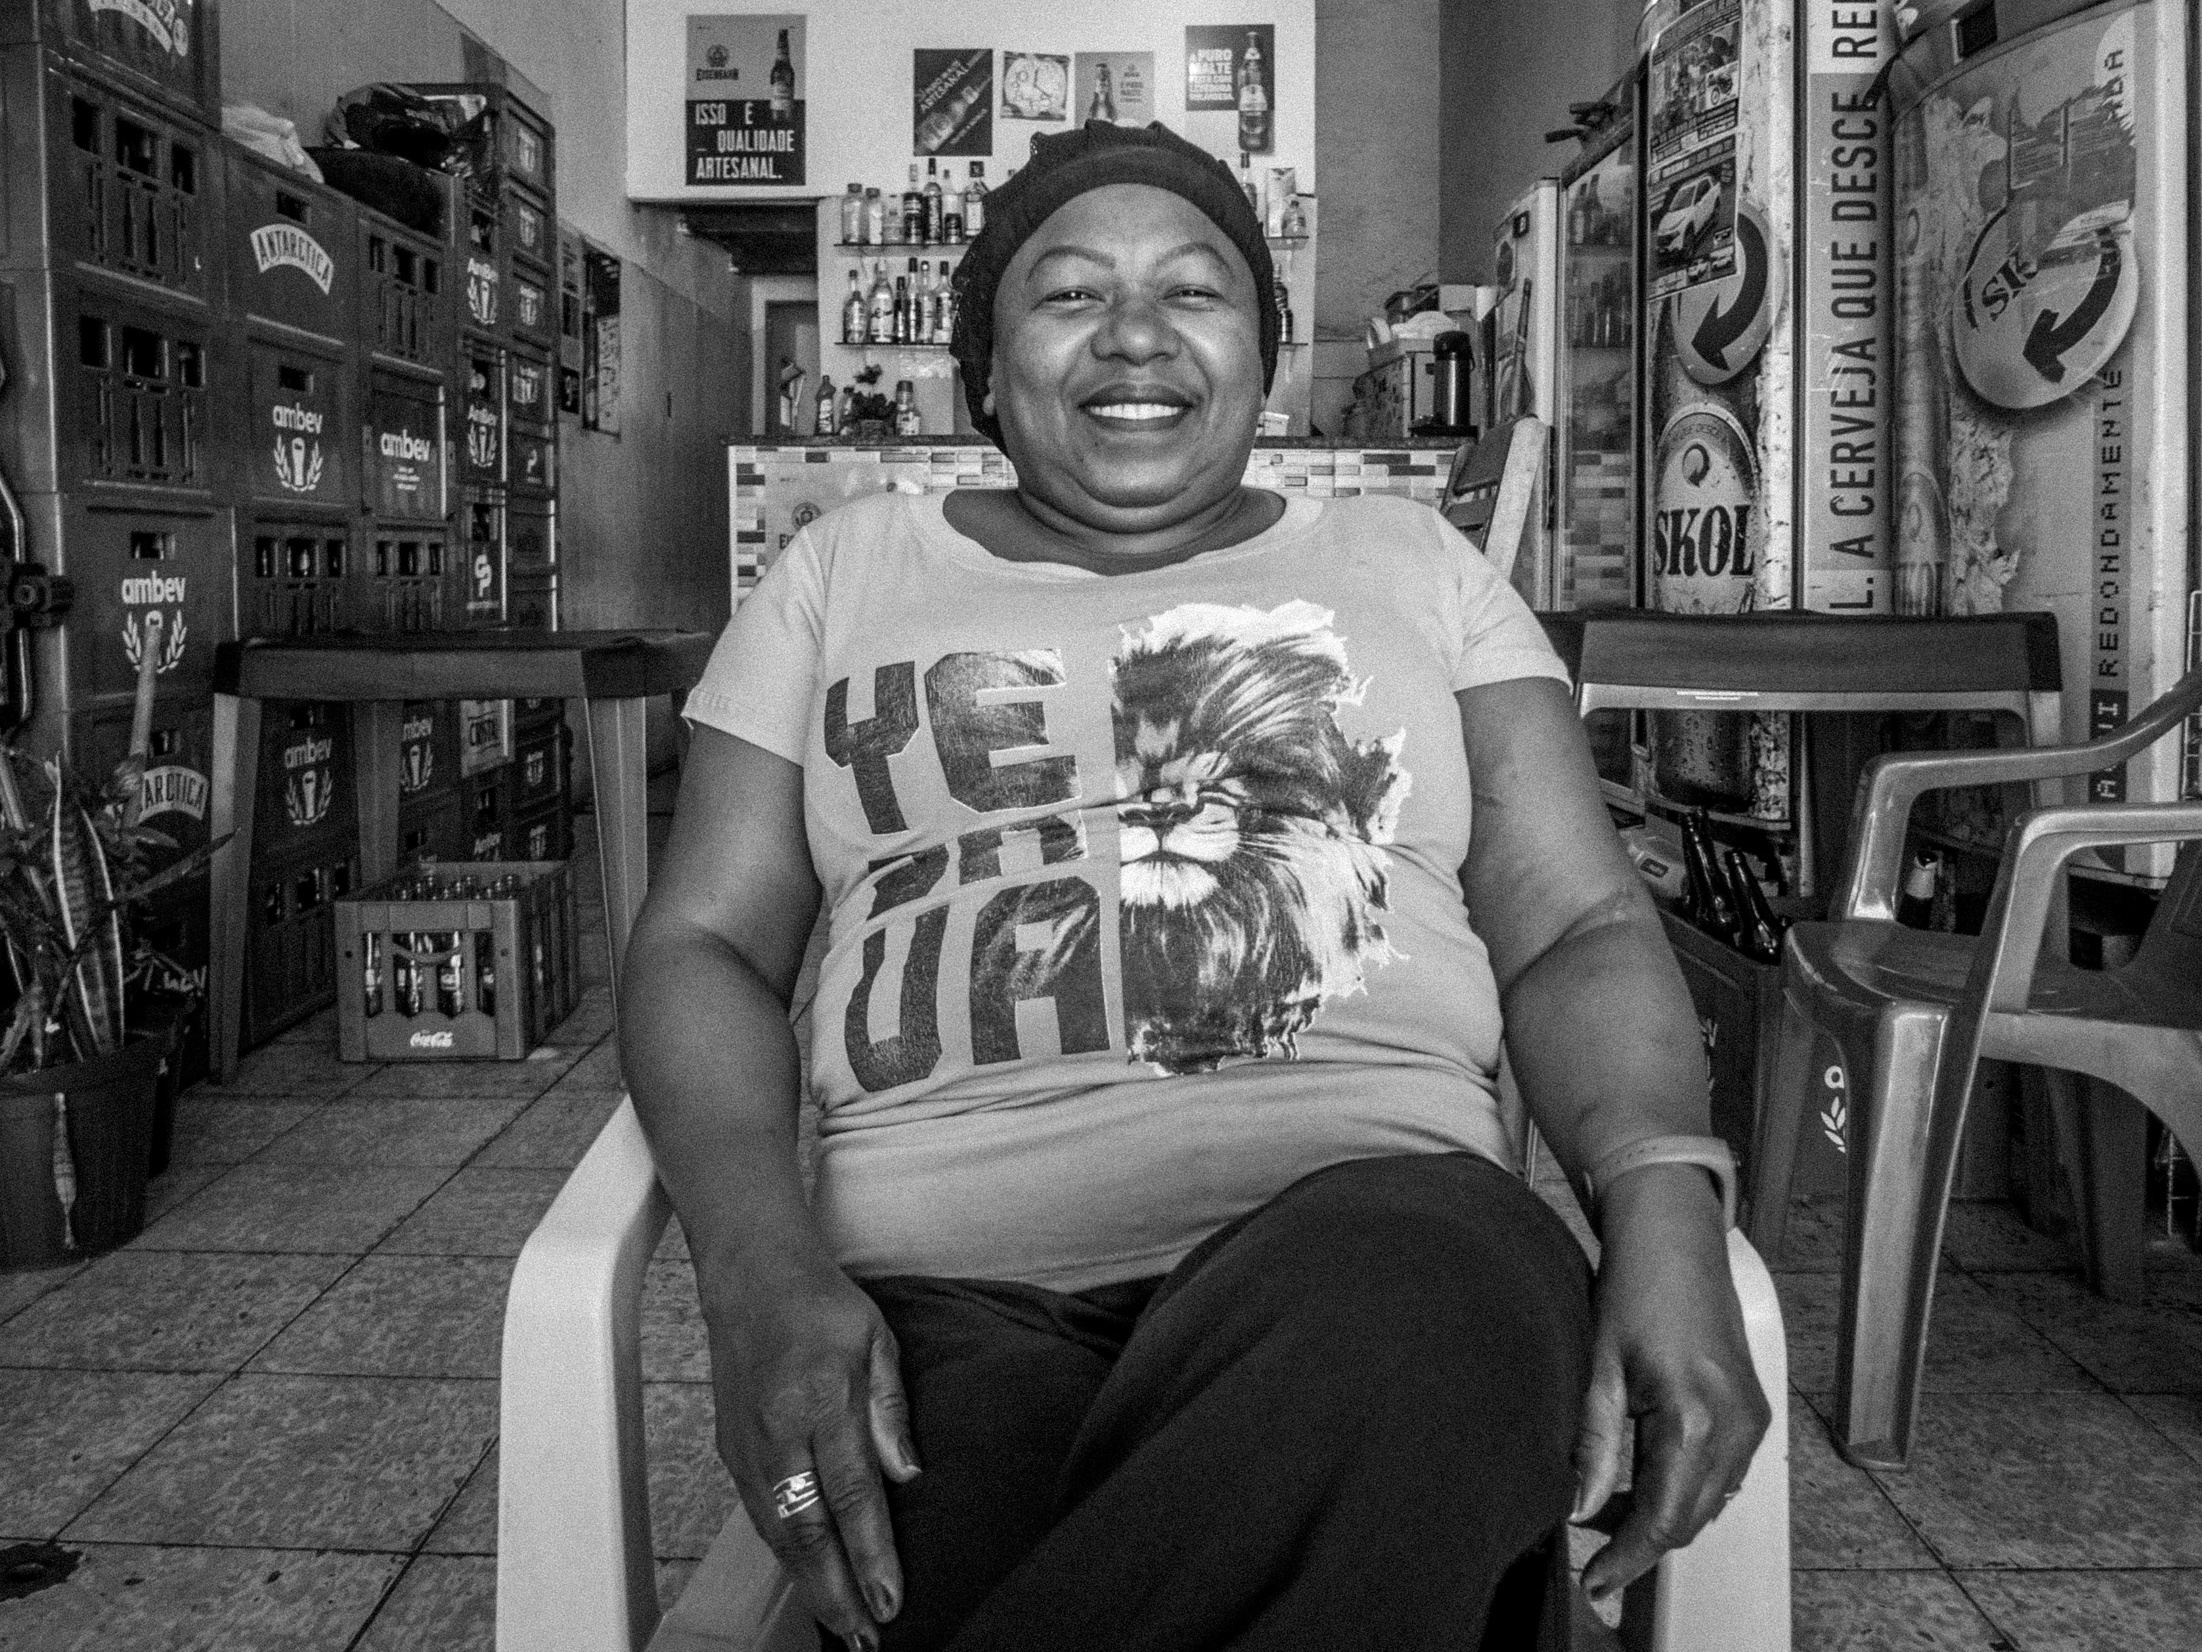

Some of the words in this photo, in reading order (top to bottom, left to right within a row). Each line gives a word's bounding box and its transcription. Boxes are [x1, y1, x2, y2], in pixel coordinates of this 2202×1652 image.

[1831, 0, 1878, 58] RE
[695, 103, 727, 125] ISSO
[717, 129, 795, 153] QUALIDADE
[1831, 92, 1878, 222] DESCE
[696, 156, 784, 179] ARTESANAL.
[1831, 241, 1878, 319] QUE
[1830, 337, 1877, 517] CERVEJA
[1654, 504, 1756, 578] SKOL
[1830, 533, 1876, 559] A
[121, 569, 187, 604] ambev
